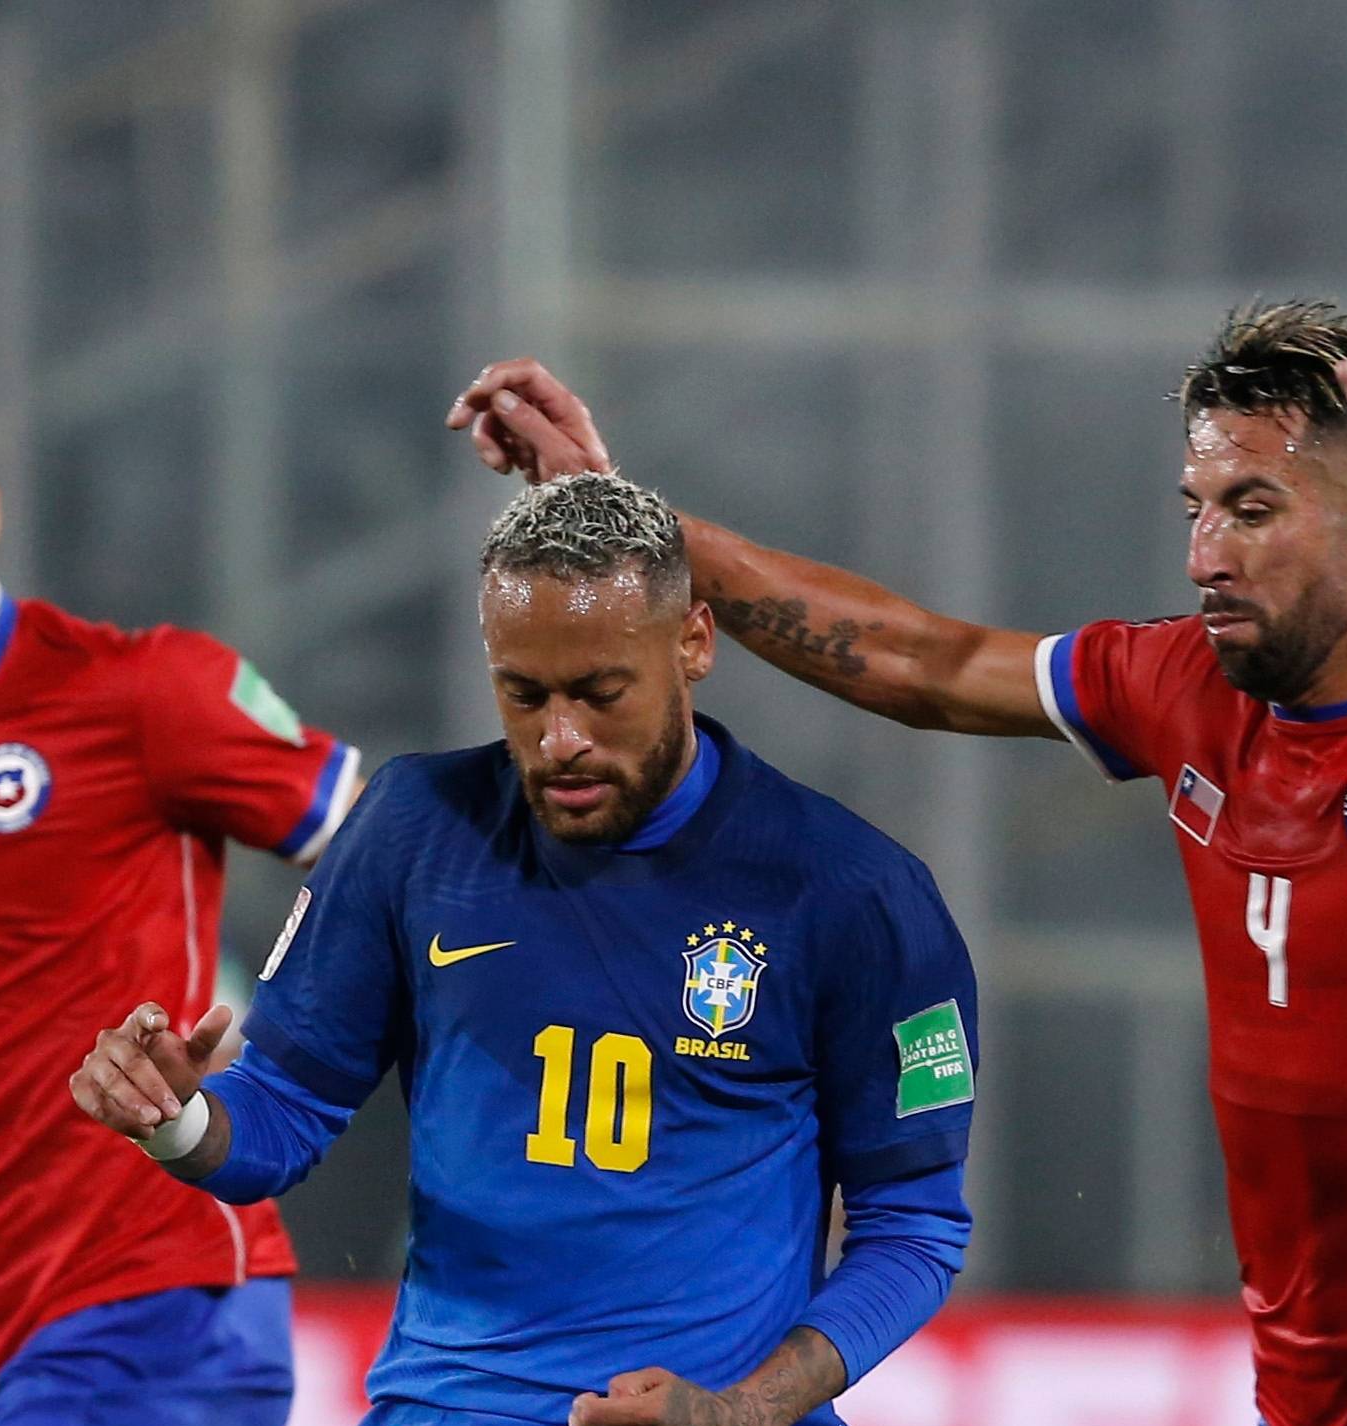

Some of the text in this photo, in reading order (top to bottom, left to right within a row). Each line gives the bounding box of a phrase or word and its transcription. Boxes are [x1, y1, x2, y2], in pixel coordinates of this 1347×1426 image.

[1245, 872, 1292, 1007] 4
[706, 977, 735, 990] CBF
[674, 1036, 751, 1061] BRASIL
[934, 1062, 964, 1079] FIFA
[525, 1024, 652, 1173] 10
